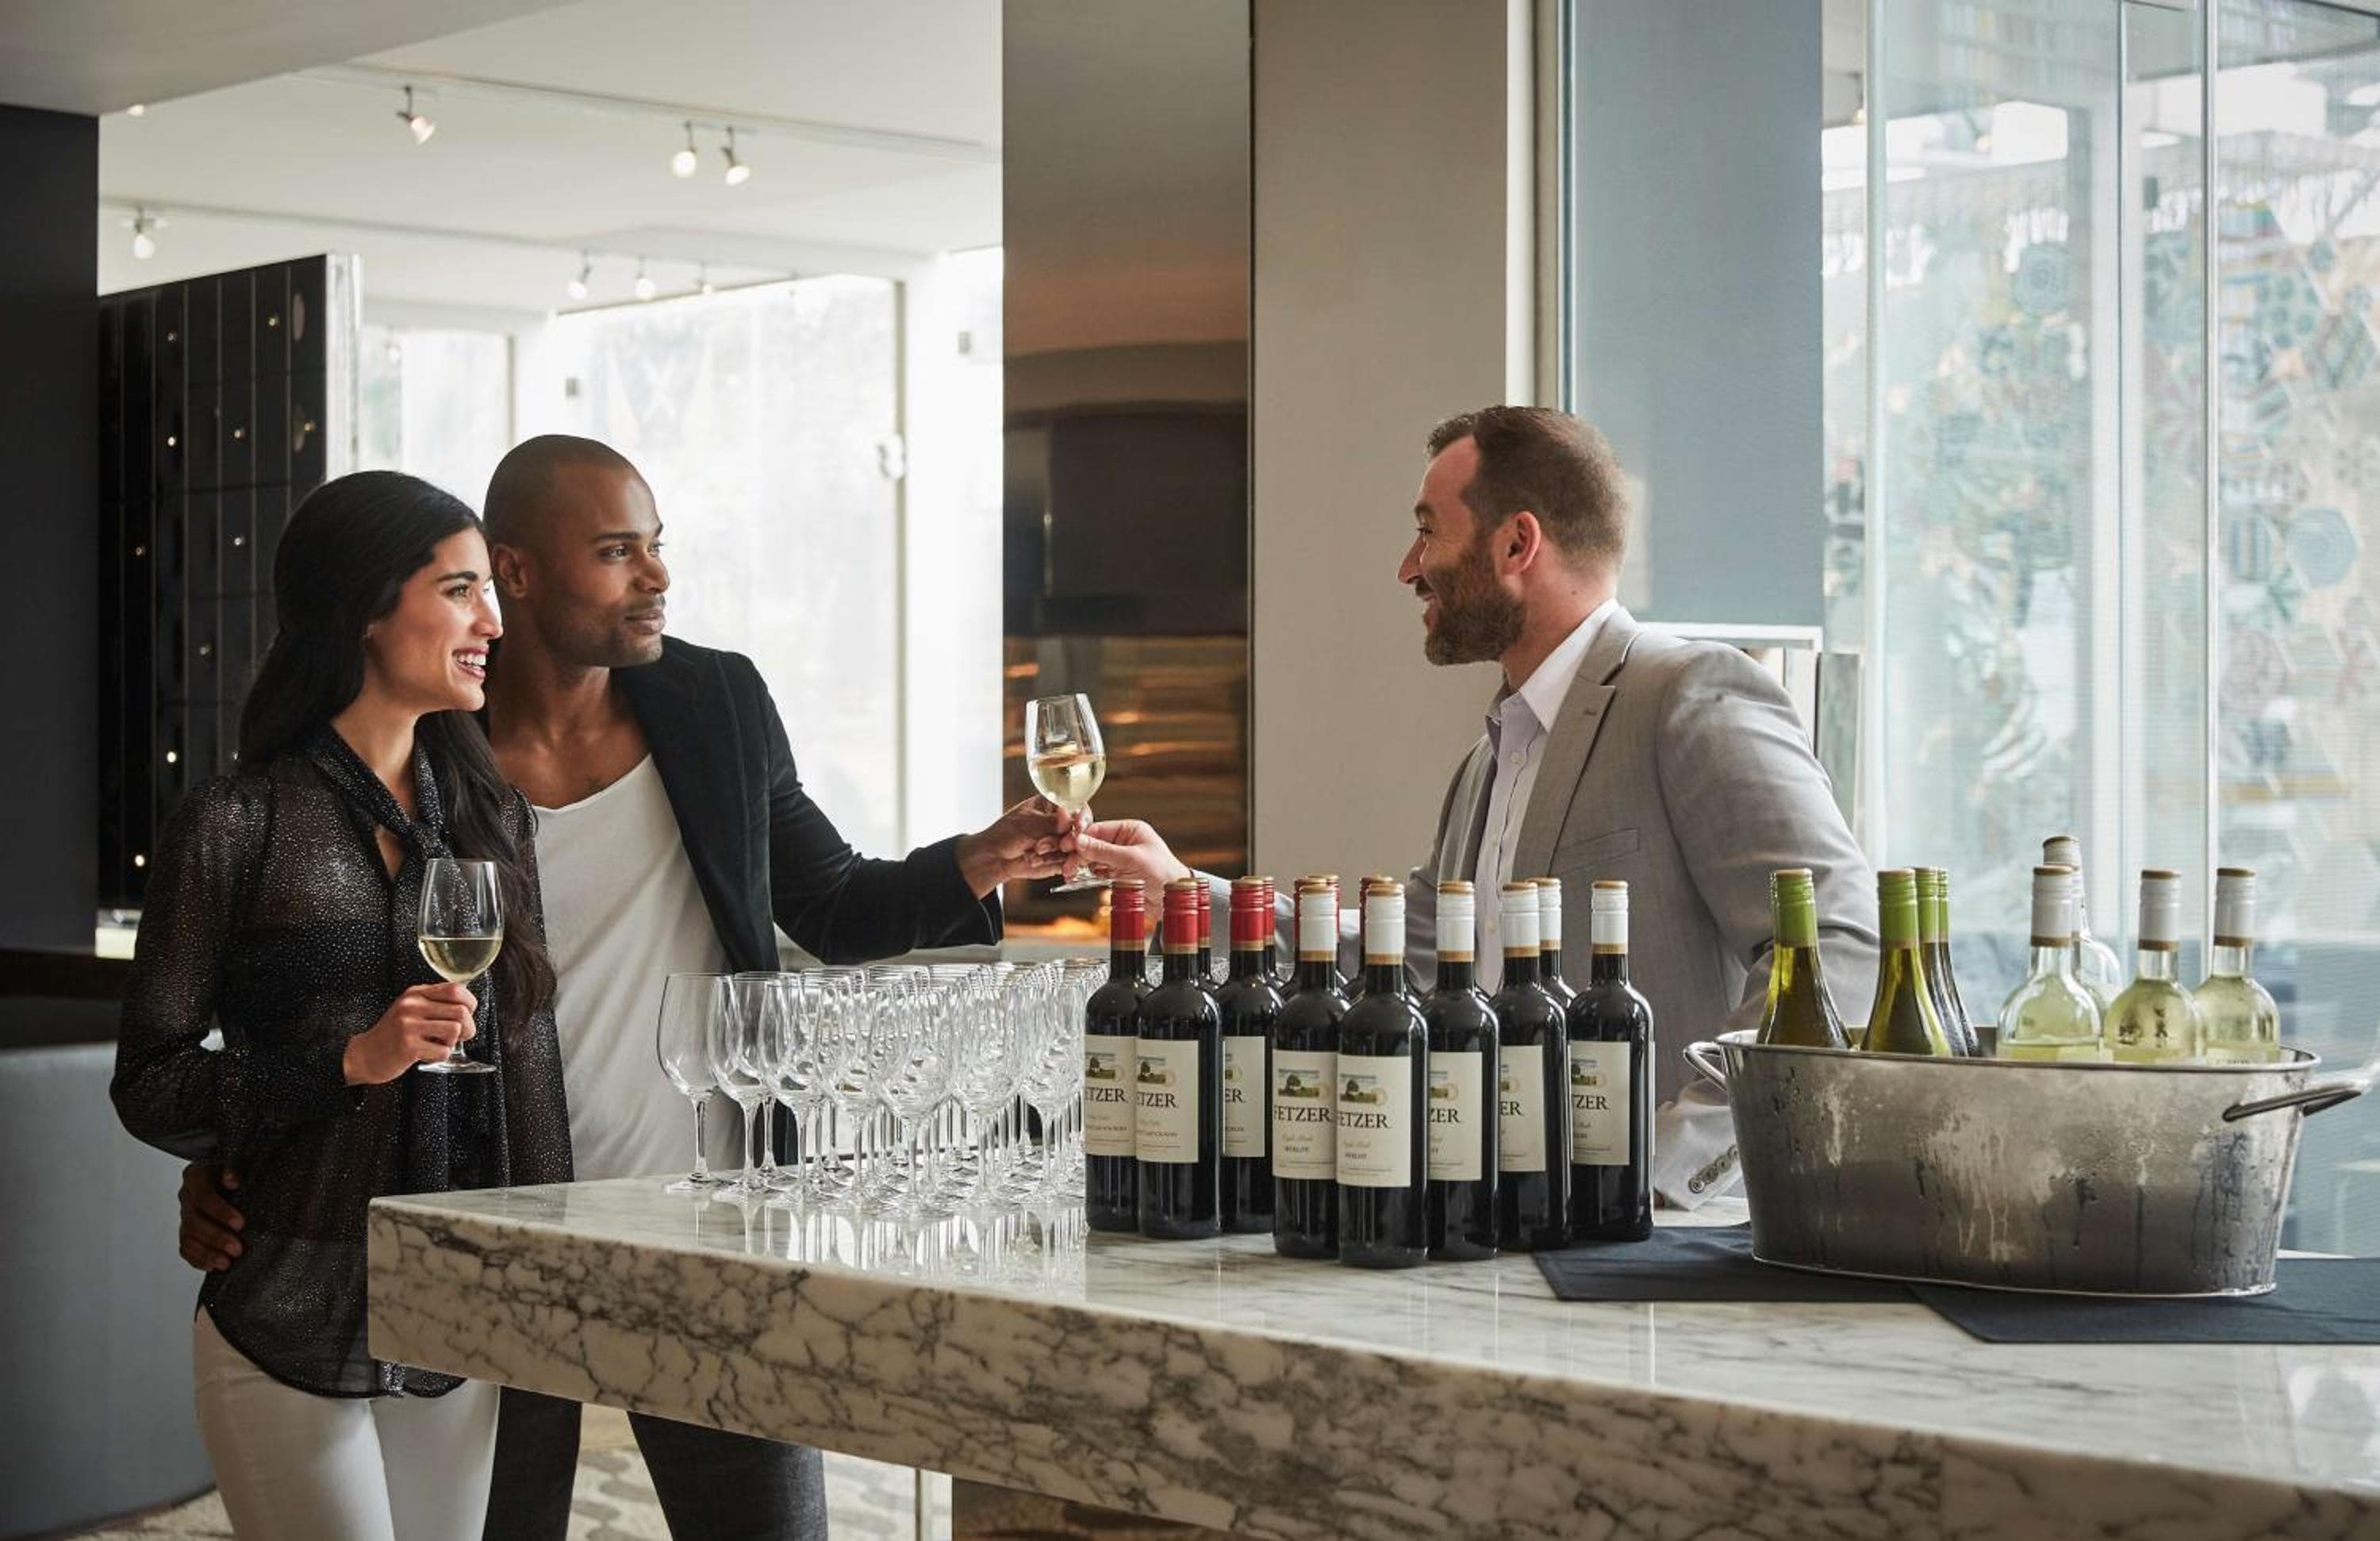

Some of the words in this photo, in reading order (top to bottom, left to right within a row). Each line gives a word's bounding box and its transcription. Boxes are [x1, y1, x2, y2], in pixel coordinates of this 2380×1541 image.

[1085, 1086, 1127, 1102] ETZER
[1136, 1091, 1177, 1108] ETZER
[1337, 1111, 1389, 1129] ETZER
[1429, 1108, 1460, 1123] ZER
